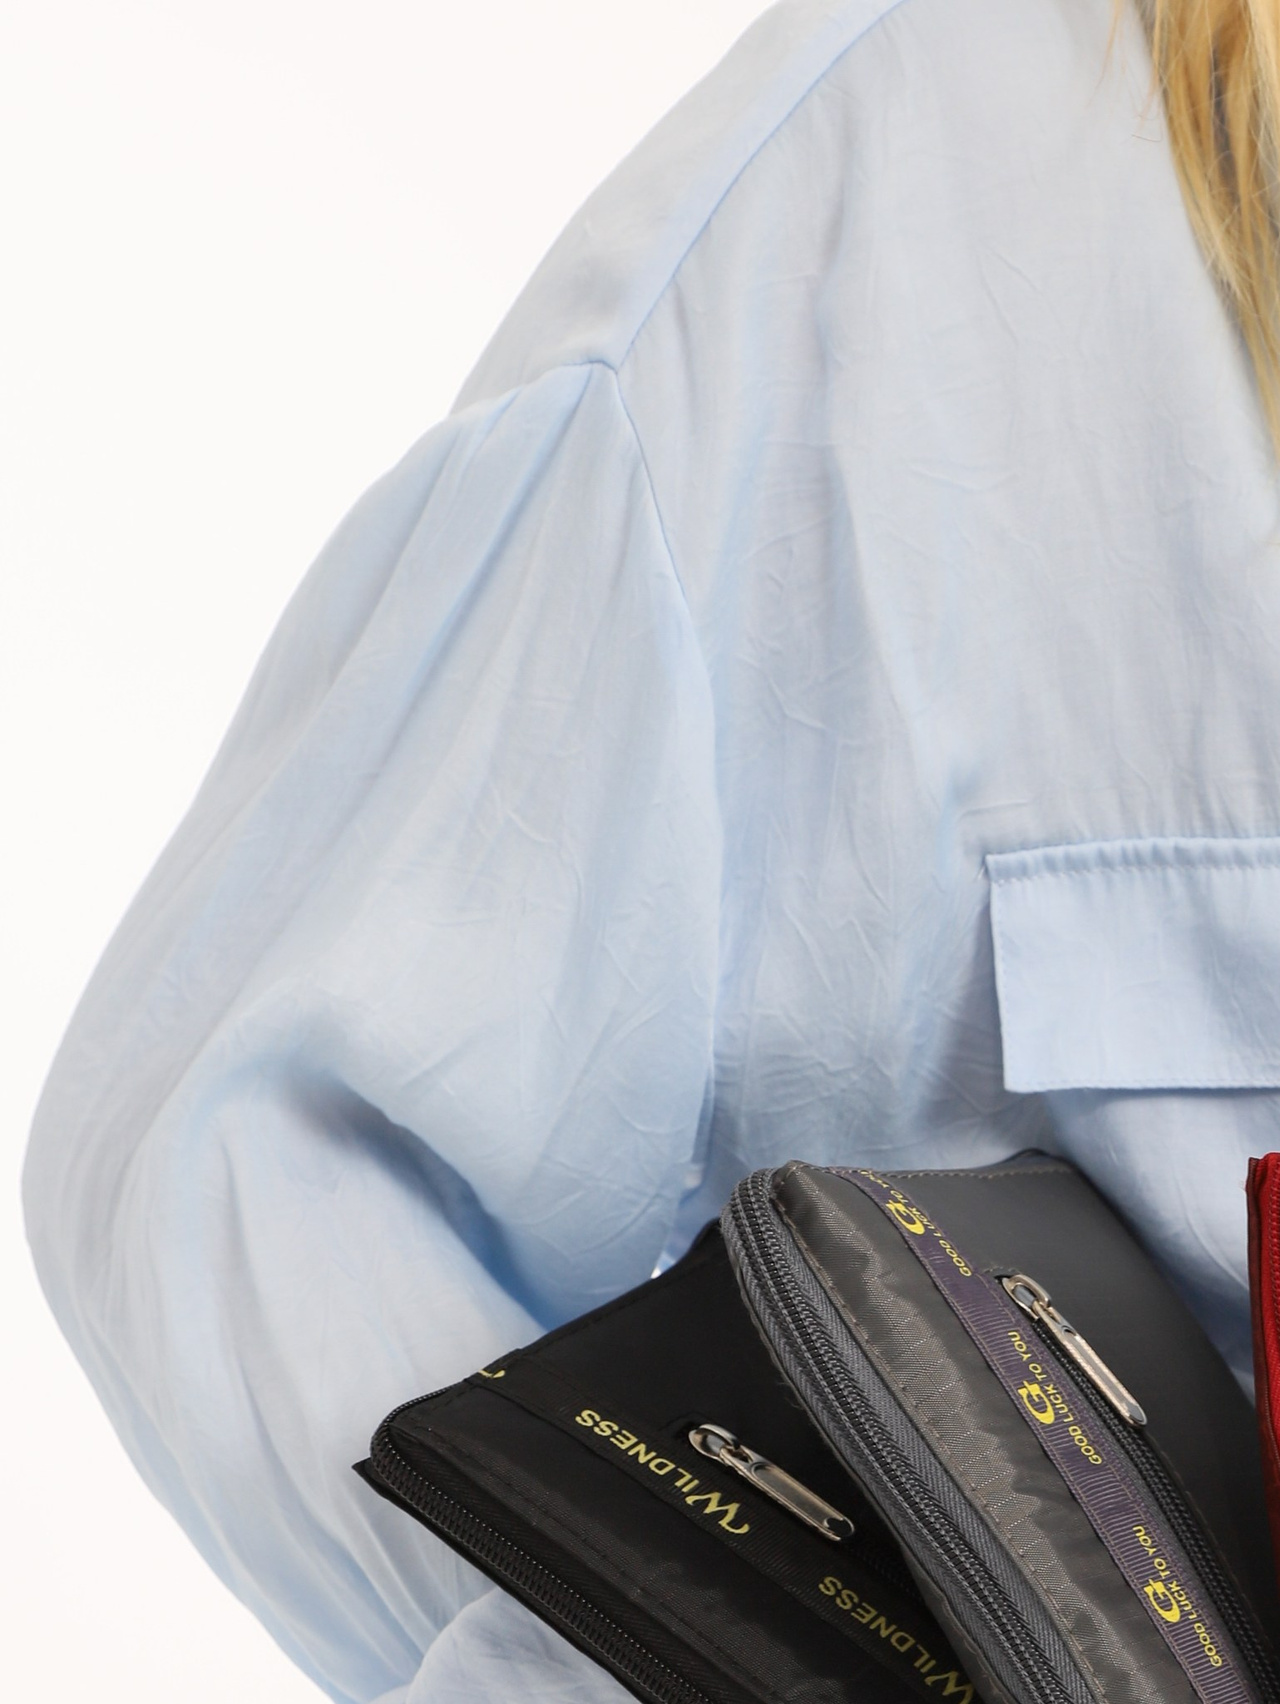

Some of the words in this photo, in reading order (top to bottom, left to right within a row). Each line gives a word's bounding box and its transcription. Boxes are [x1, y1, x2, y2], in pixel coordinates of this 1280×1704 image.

[1007, 1331, 1031, 1361] YOU
[1029, 1363, 1047, 1382] TO
[1018, 1381, 1054, 1424] G
[1043, 1383, 1074, 1423] LUCK
[1068, 1425, 1102, 1465] GOOD
[575, 1409, 750, 1534] WILDNESS
[1132, 1525, 1157, 1556] YOU
[1154, 1558, 1170, 1579] TO
[1143, 1578, 1180, 1623] G
[1168, 1580, 1197, 1619] LUCK
[1194, 1622, 1222, 1667] GOOD
